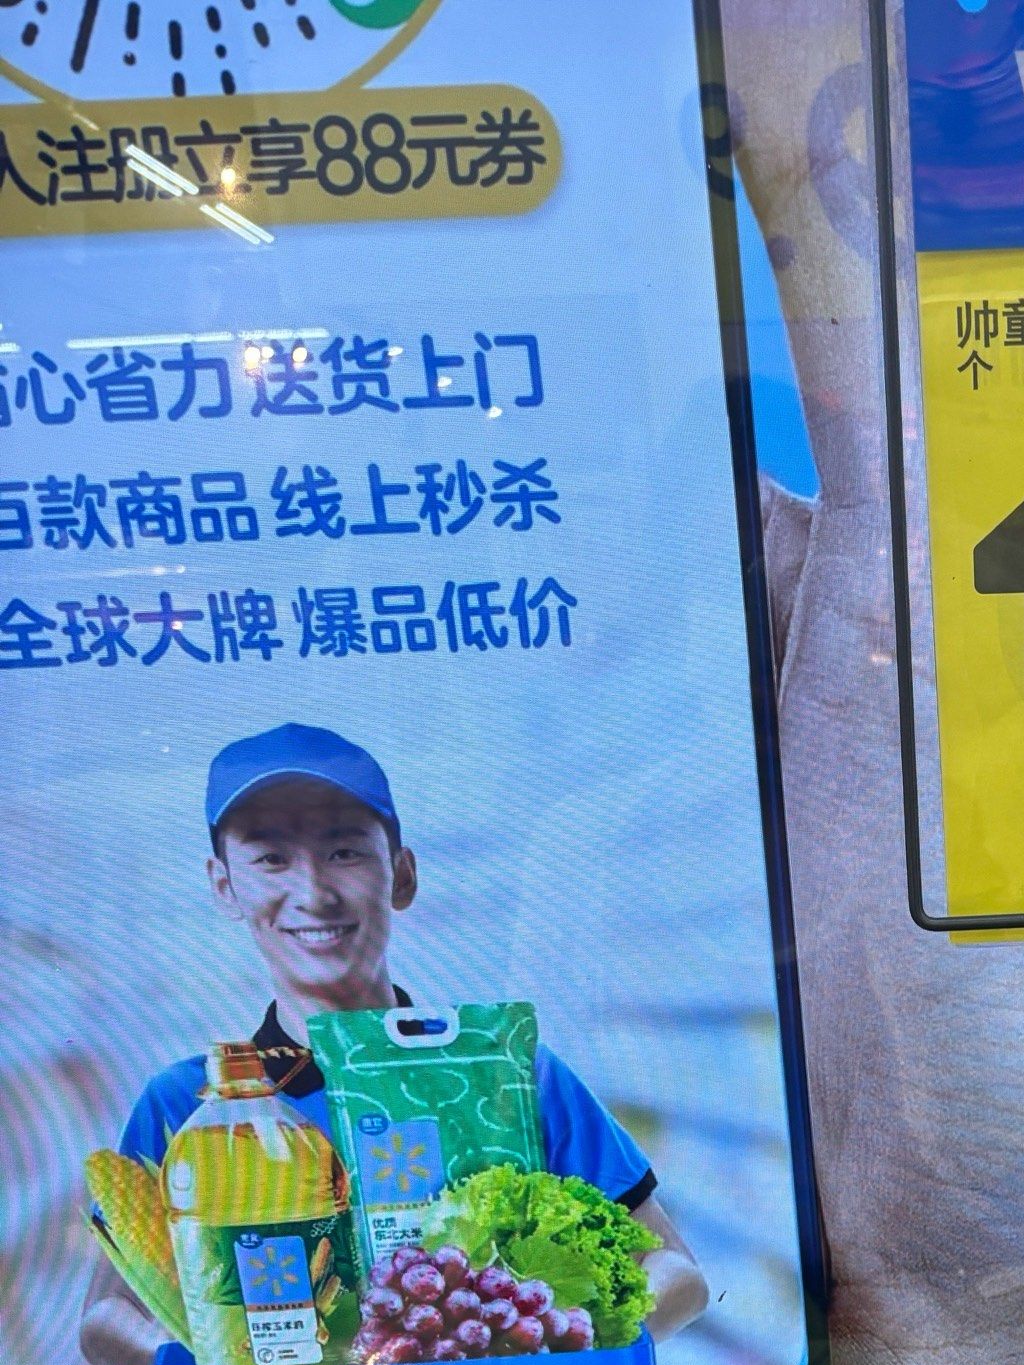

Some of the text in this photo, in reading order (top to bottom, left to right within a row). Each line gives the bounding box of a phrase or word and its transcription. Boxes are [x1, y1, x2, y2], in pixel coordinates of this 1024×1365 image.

[0, 331, 545, 427] 心省力 送货上门
[957, 351, 994, 391] 个
[273, 458, 562, 541] 线上秒杀
[0, 576, 578, 668] 全球大牌 爆品低价
